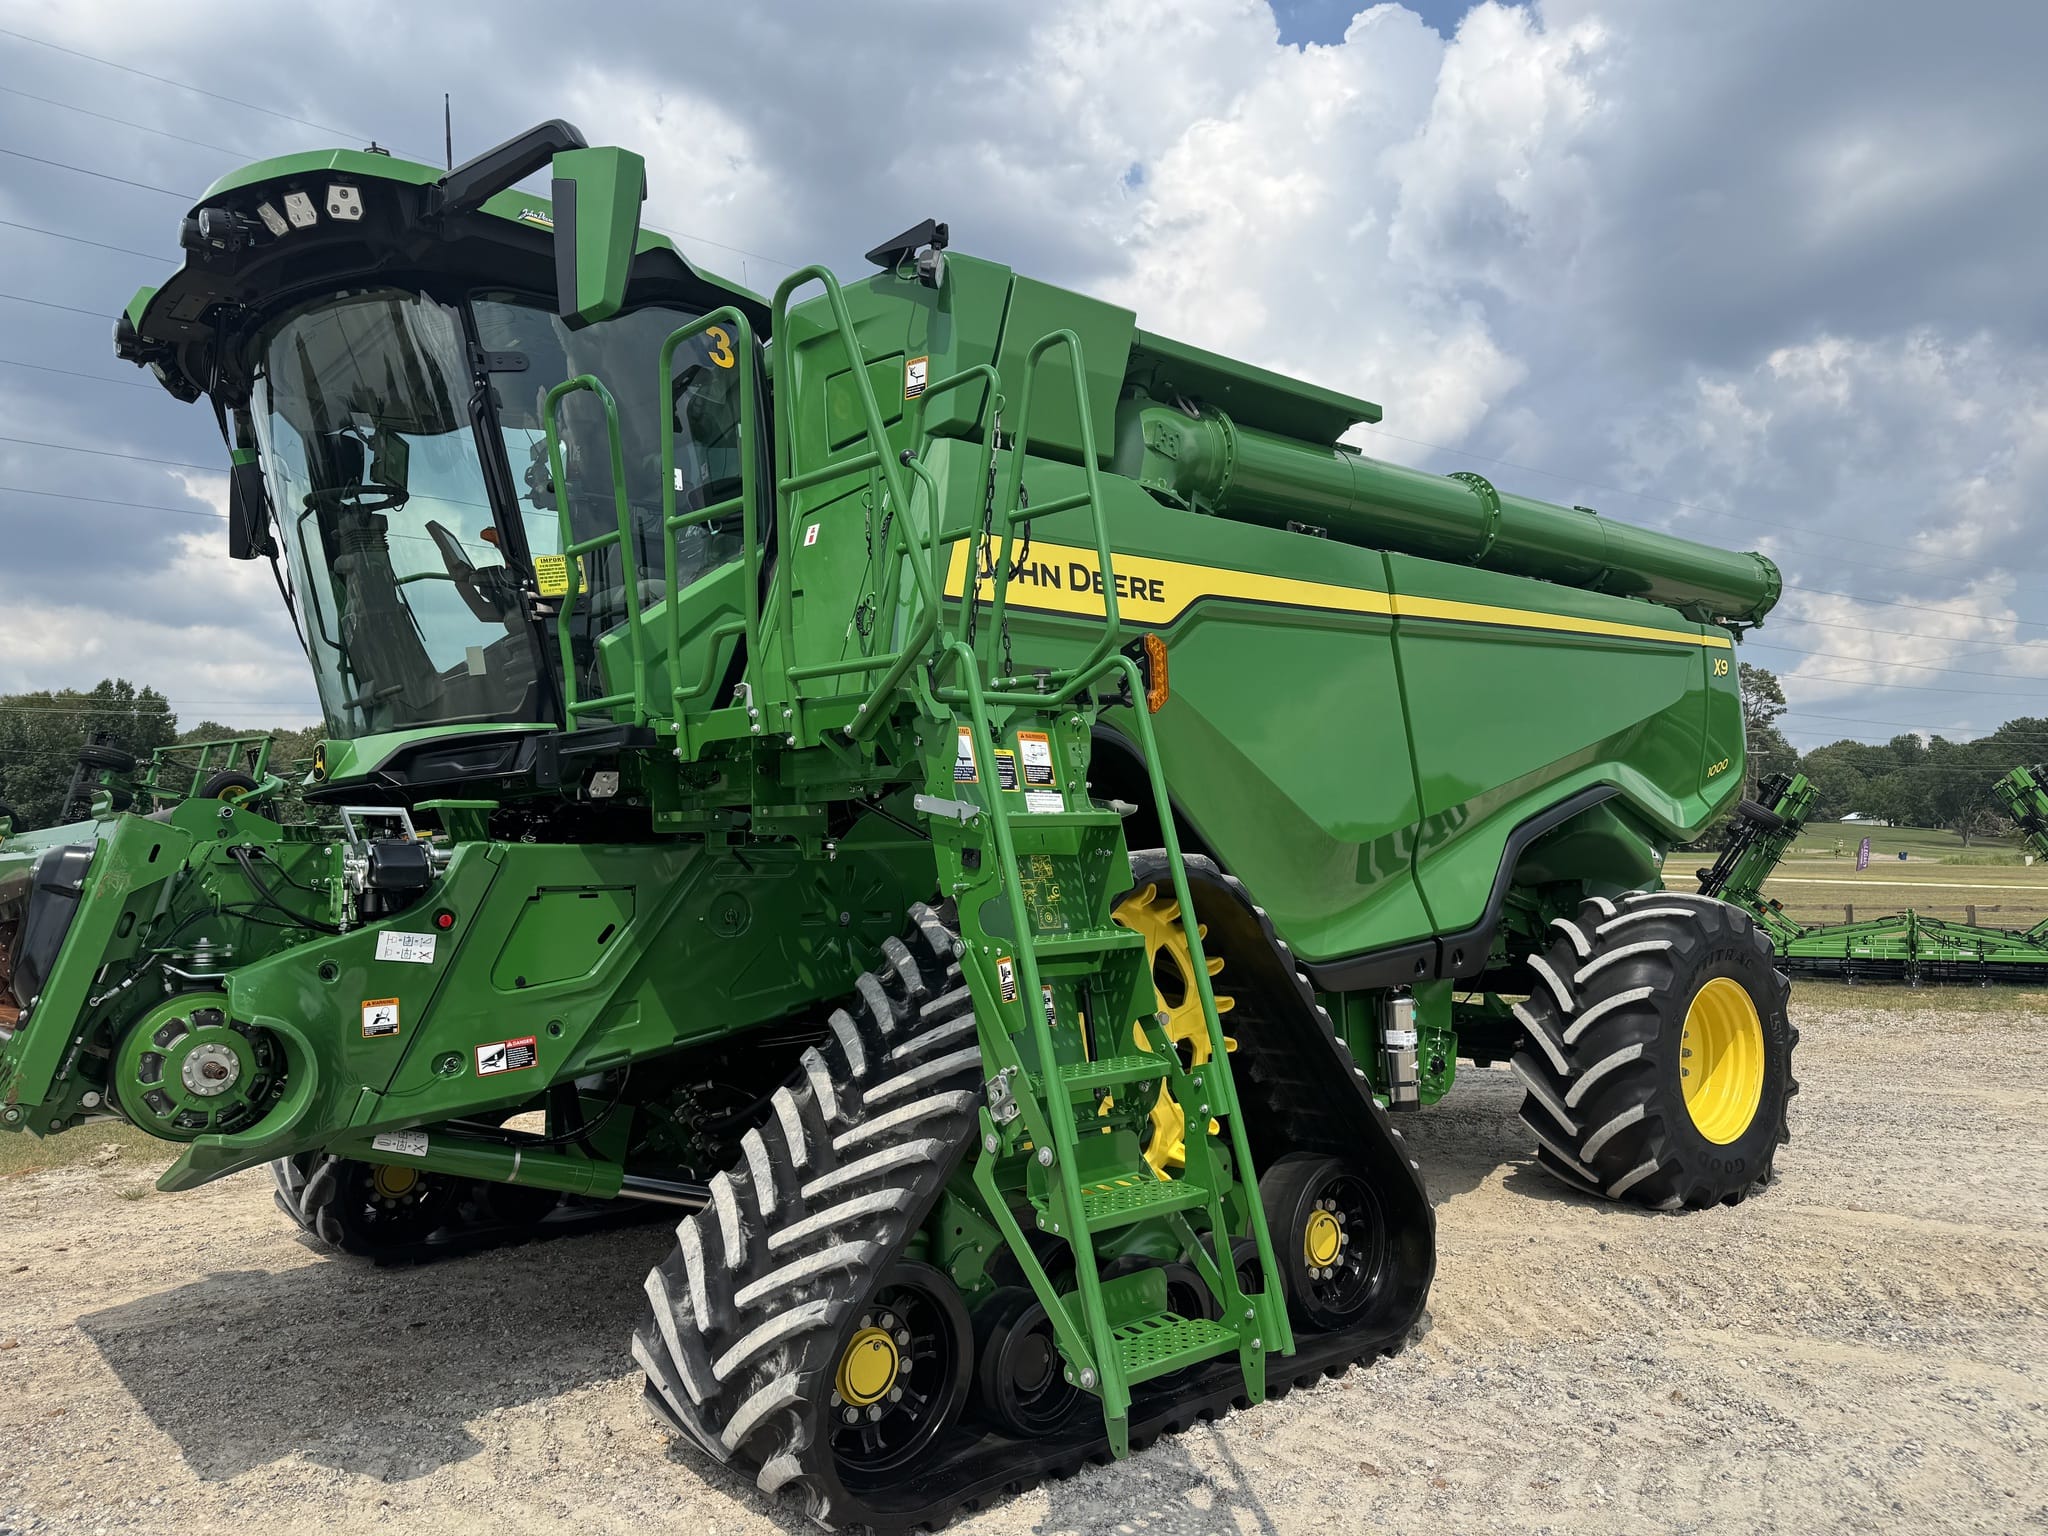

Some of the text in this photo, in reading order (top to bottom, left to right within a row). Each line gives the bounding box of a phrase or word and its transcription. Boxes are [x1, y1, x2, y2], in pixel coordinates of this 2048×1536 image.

[705, 326, 735, 369] 3
[1069, 562, 1165, 603] DEERE
[1713, 658, 1729, 677] X9
[1706, 758, 1729, 778] 1000
